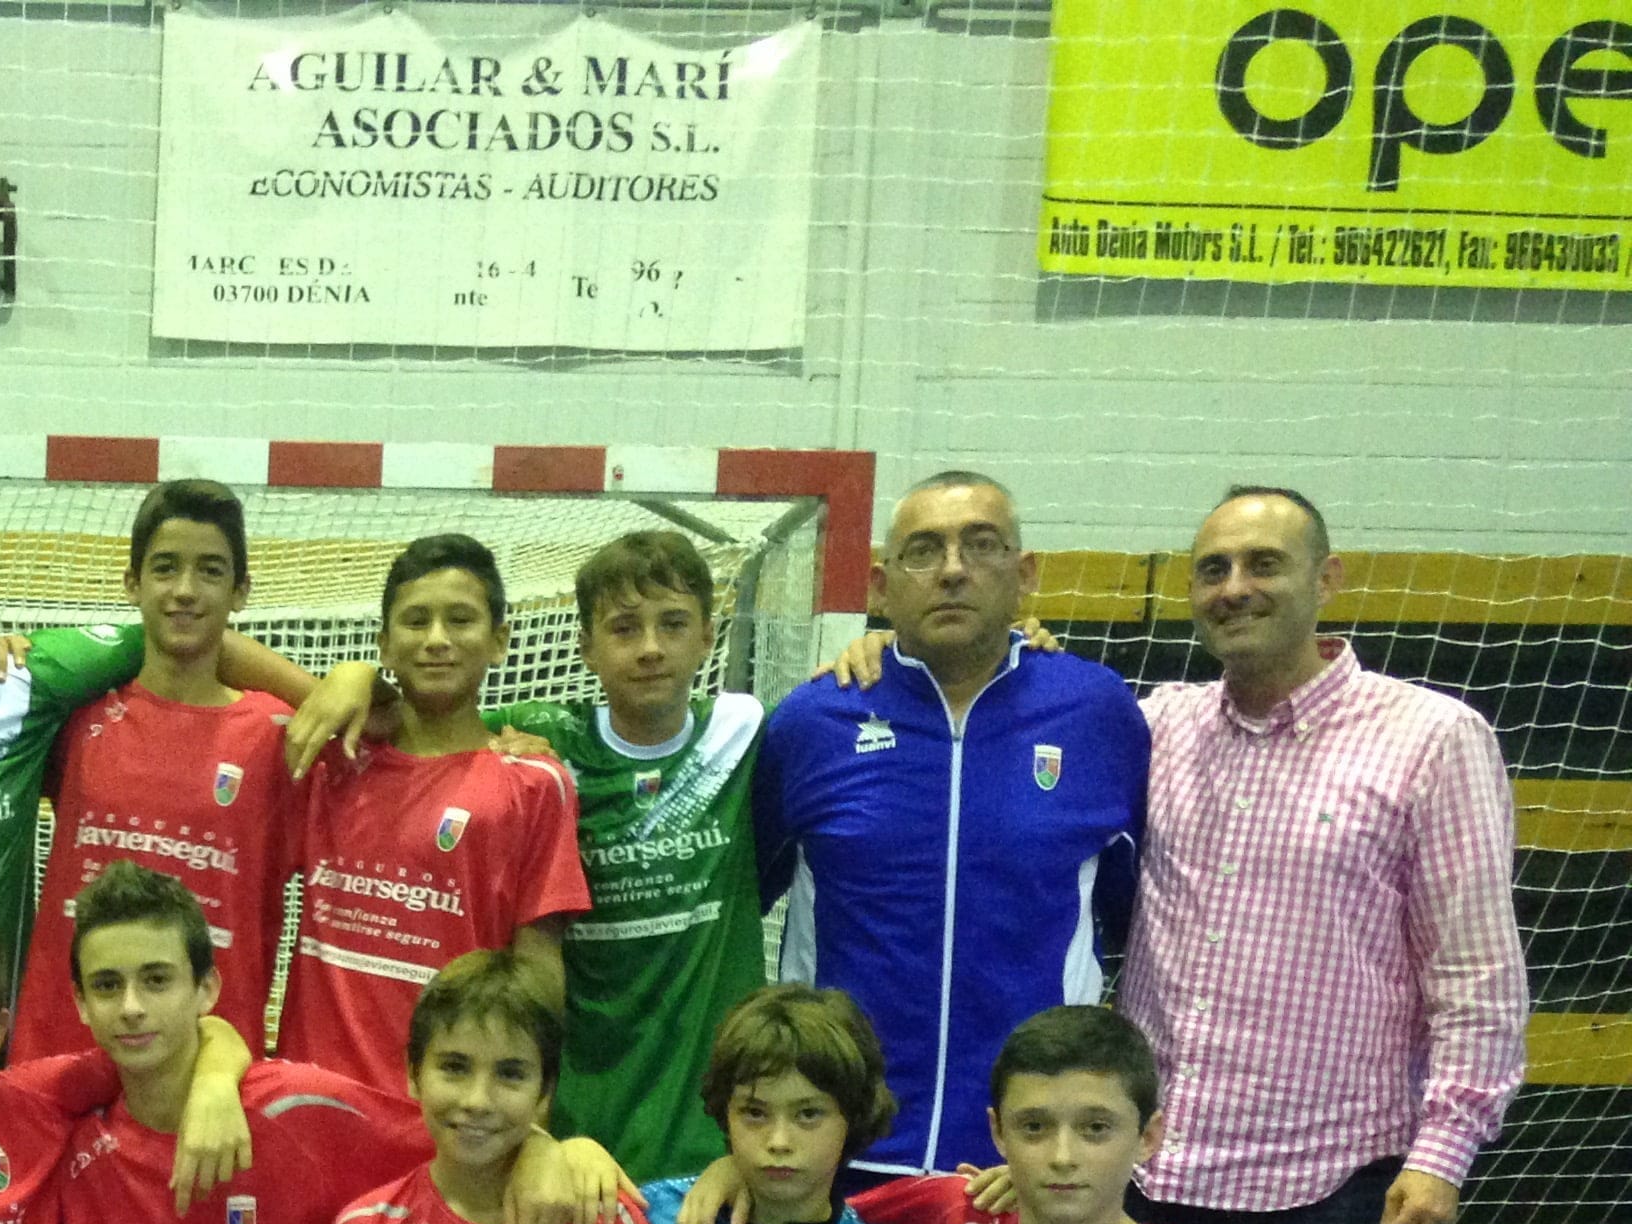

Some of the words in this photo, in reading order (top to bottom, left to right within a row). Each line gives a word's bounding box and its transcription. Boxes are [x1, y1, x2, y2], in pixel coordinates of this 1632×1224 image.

[247, 50, 504, 95] AGUILAR
[521, 56, 564, 96] &
[312, 106, 634, 152] ASOCIADOS
[651, 121, 720, 153] S.L.
[250, 168, 493, 201] ECONOMISTAS
[523, 171, 720, 202] AUDITORES
[1050, 217, 1090, 256] Auto
[1096, 219, 1148, 259] Denia
[1155, 221, 1223, 262] Motors
[213, 284, 278, 303] 03700
[287, 278, 371, 303] DÉNIA
[385, 930, 441, 950] seguro
